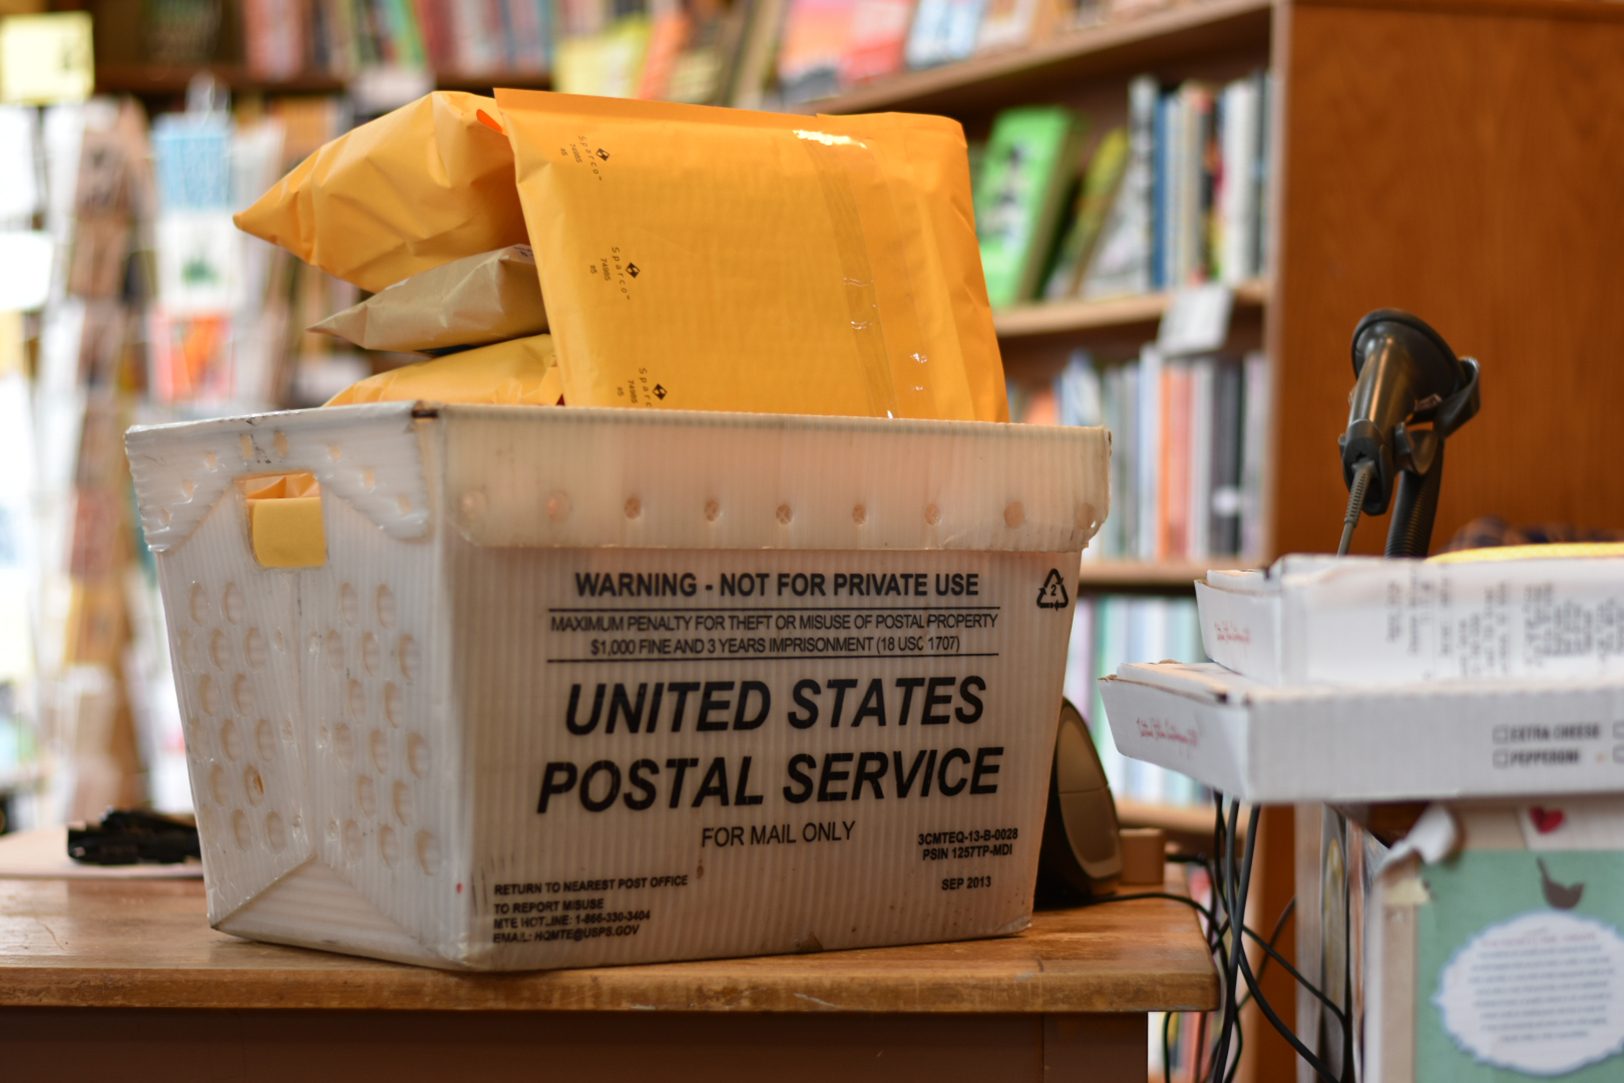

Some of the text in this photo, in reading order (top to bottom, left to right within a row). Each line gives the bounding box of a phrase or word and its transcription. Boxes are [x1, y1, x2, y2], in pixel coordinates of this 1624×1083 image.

[575, 572, 698, 597] WARNING
[719, 573, 771, 597] NOT
[777, 573, 827, 596] FOR
[833, 573, 928, 596] PRIVATE
[935, 573, 980, 596] USE
[551, 613, 999, 632] MAXIMUM PENALTY FOR THEFT OR MISUSE OF POSTAL PROPERTY
[590, 635, 961, 656] $1,000 FINE AND 3 YEARS IMPRISONMENT (18 USC 1707)
[565, 675, 987, 736] UNITED STATES
[536, 746, 1004, 814] POSTAL SERVICE
[702, 820, 856, 848] FOR MAIL ONLY
[918, 827, 1019, 846] 3CMTEQ-13-B-0028
[922, 843, 1013, 860] PSIN 1257TP-MDI
[494, 874, 689, 896] RETURN TO NEAREST POST OFFICE
[941, 875, 992, 891] SEP 2013
[494, 898, 605, 915] TO REPORT MISUSE
[493, 917, 518, 930] MTE
[534, 924, 640, 942] HQMTE@USPS.GOV
